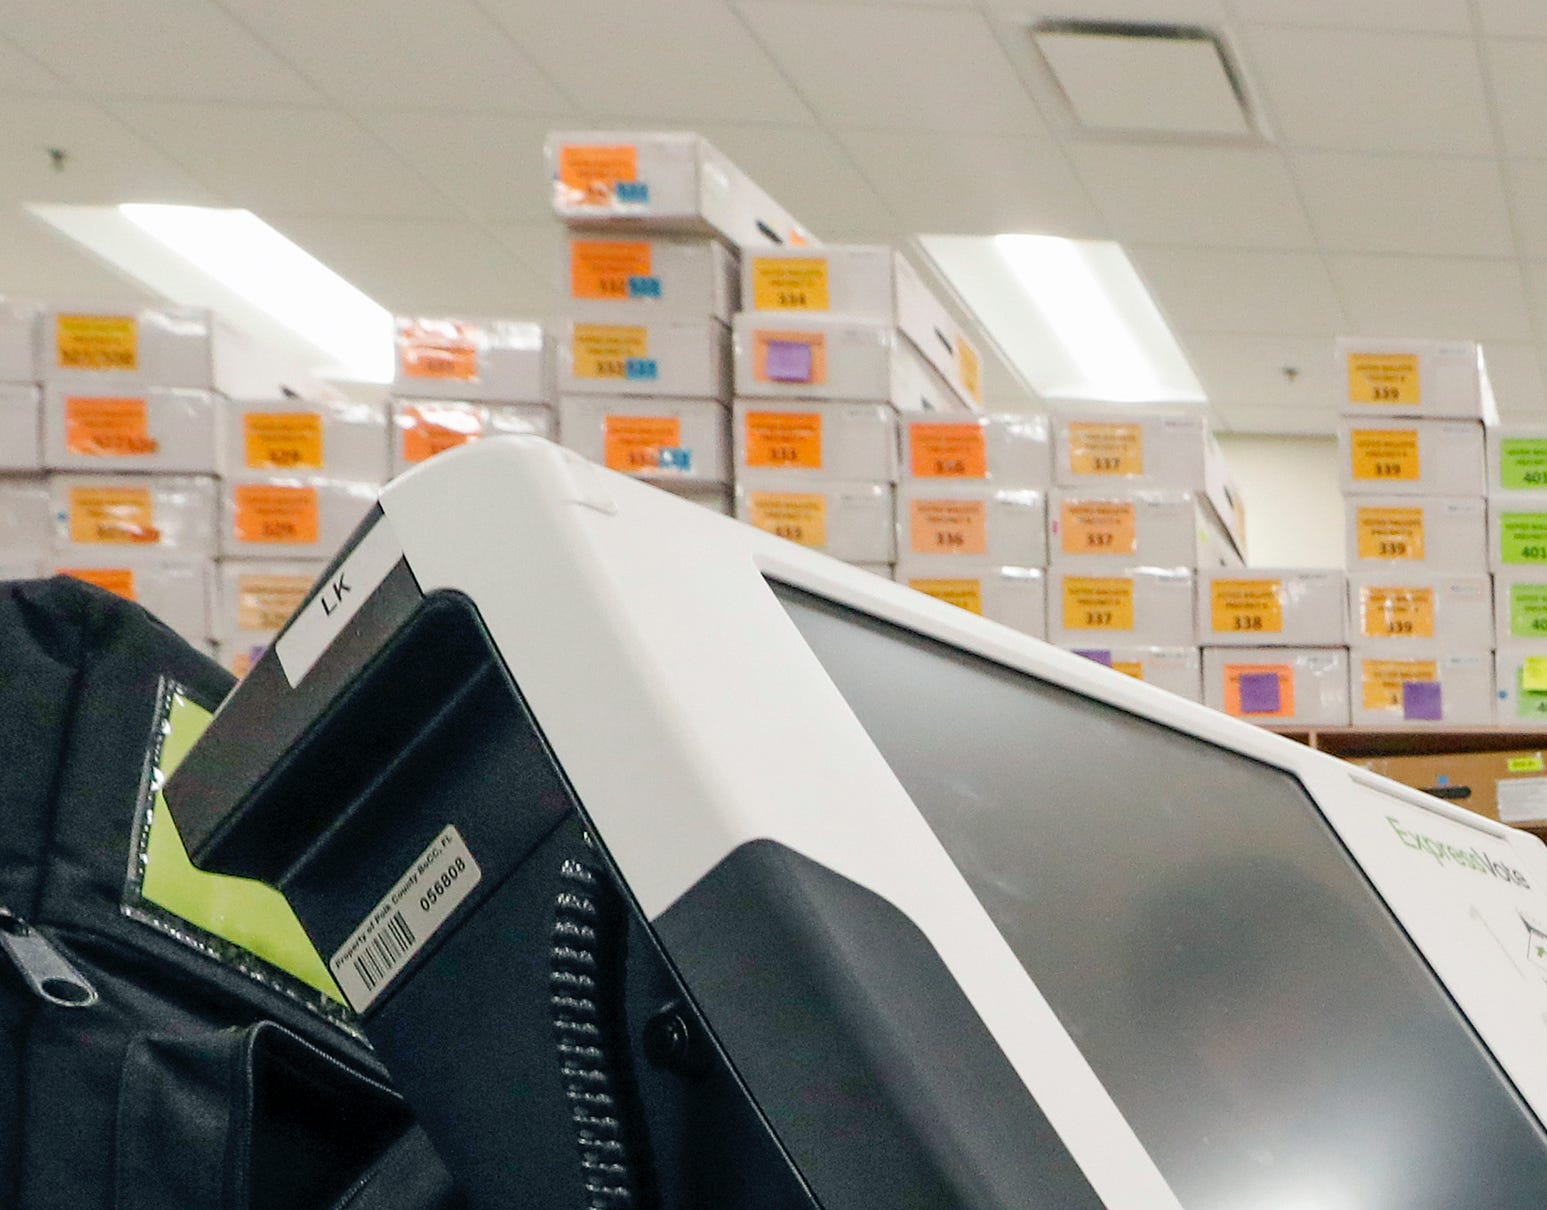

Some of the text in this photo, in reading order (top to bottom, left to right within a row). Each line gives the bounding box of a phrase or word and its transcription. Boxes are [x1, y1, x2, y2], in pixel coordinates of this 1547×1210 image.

[1521, 546, 1547, 561] 401
[321, 572, 351, 616] LK
[1385, 816, 1531, 890] ExpressVote
[420, 857, 466, 912] 056808
[335, 931, 368, 969] Property
[366, 919, 376, 933] of
[374, 904, 392, 926] Polk
[391, 876, 420, 905] County
